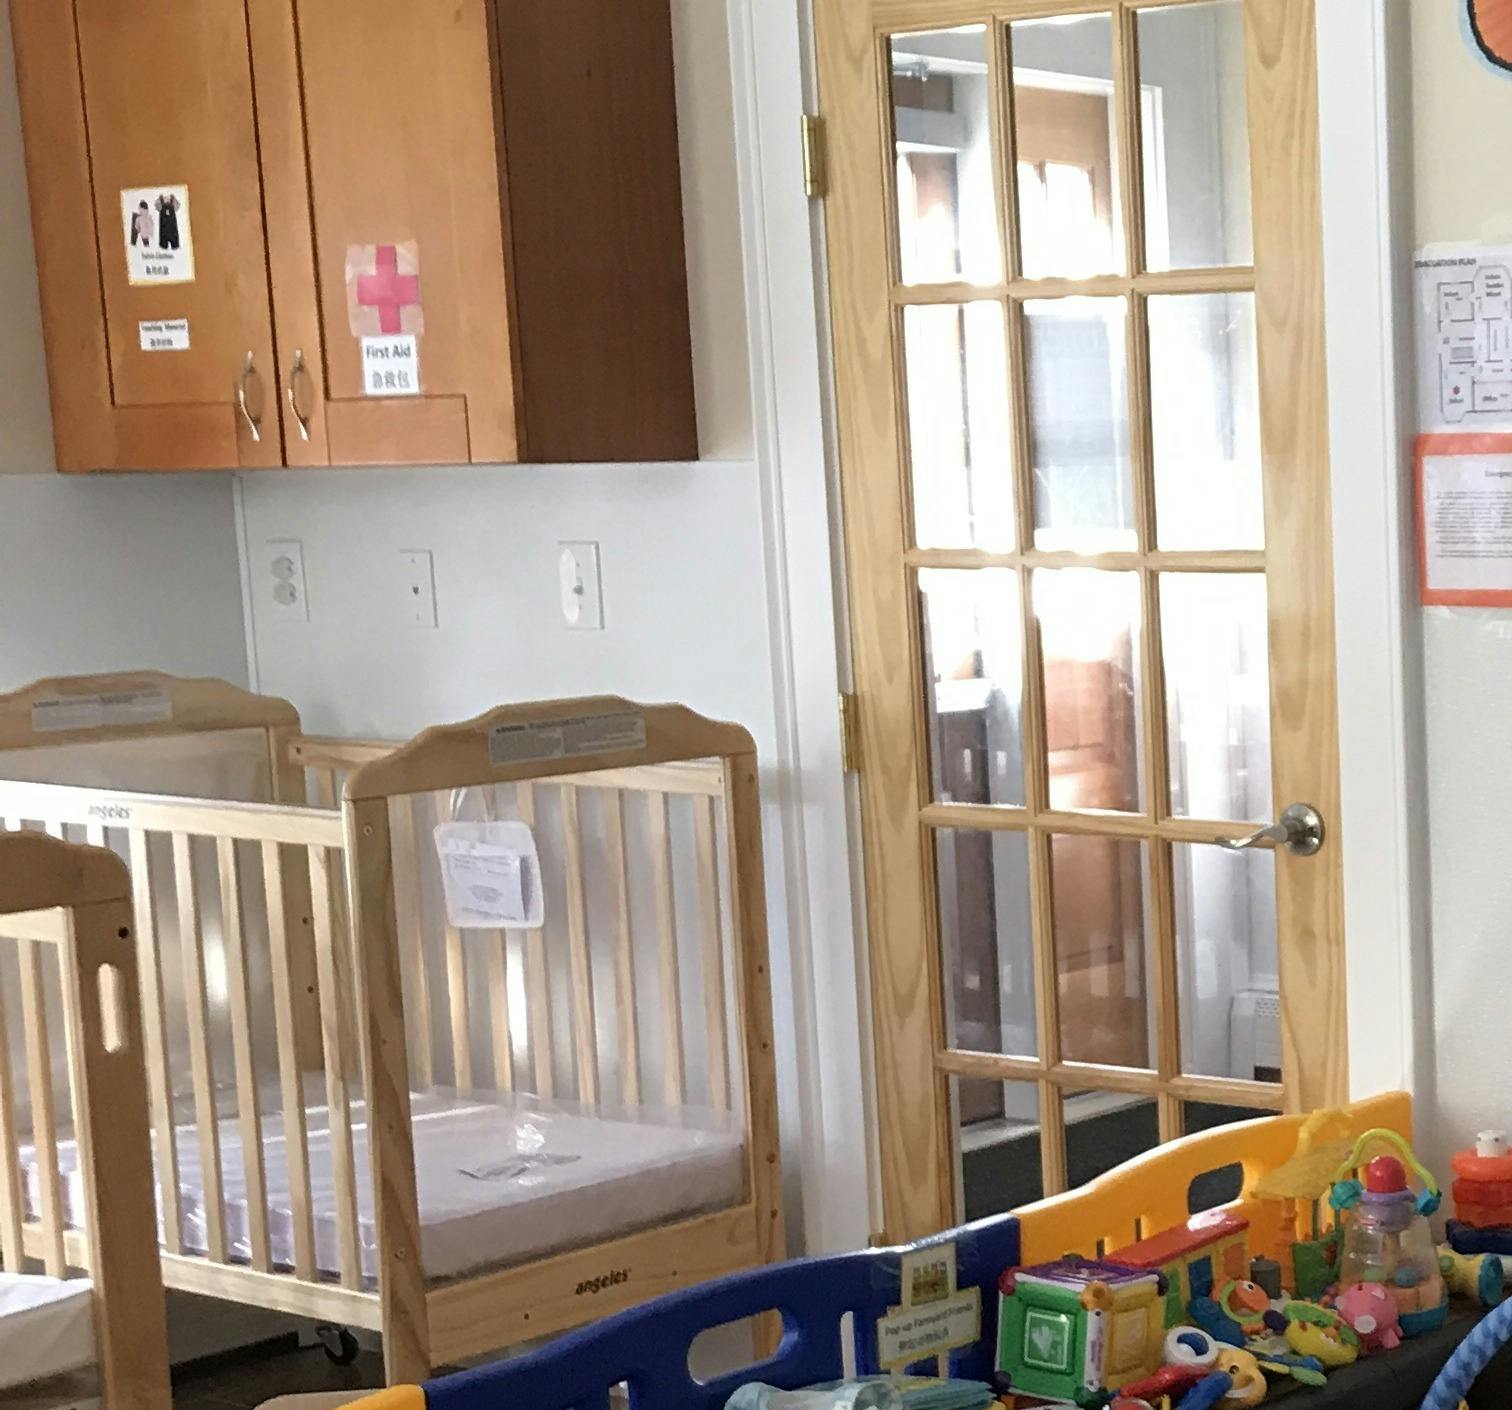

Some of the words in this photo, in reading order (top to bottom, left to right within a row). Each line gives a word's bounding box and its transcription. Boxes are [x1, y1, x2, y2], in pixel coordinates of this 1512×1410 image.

[366, 344, 389, 359] First
[392, 344, 411, 359] Aid
[576, 1269, 629, 1295] angeles
